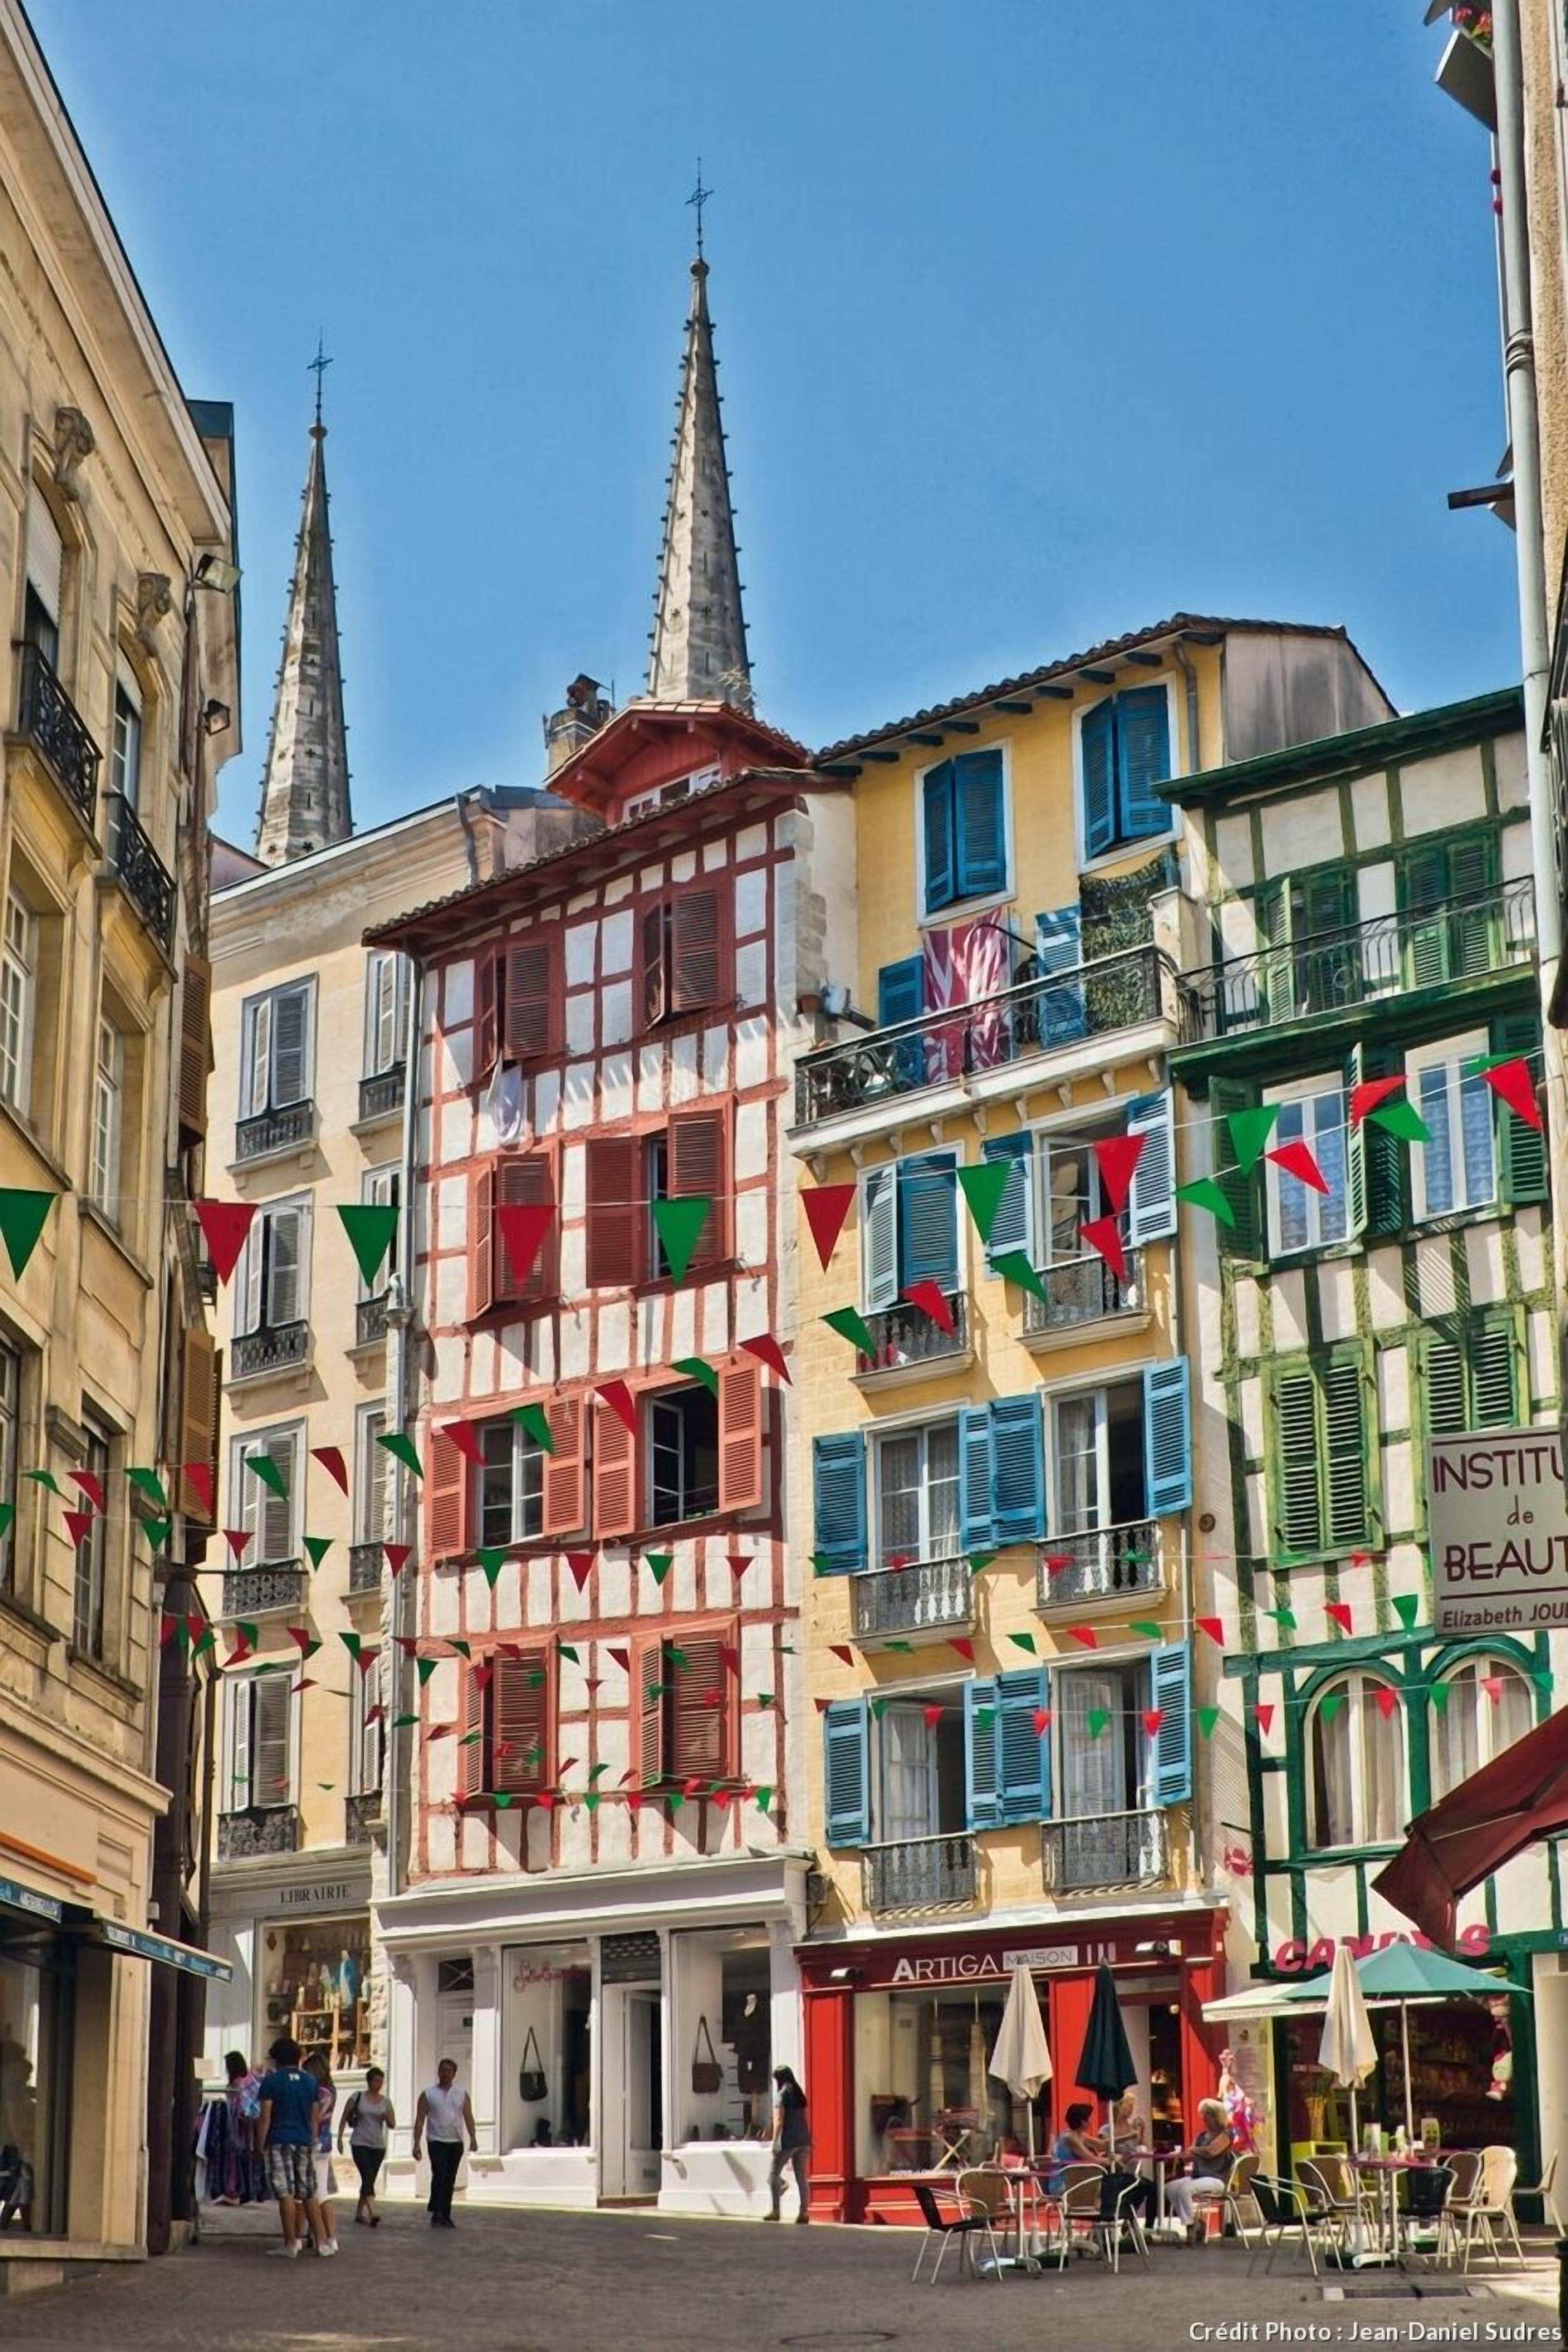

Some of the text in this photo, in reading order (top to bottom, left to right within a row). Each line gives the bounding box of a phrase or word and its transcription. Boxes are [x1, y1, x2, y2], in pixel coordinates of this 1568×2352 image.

[1507, 1494, 1534, 1525] de
[1443, 1605, 1522, 1628] Elizabeth
[280, 1885, 350, 1903] LIBRAIRIE
[892, 1951, 1071, 1981] ARTIGA MAISON
